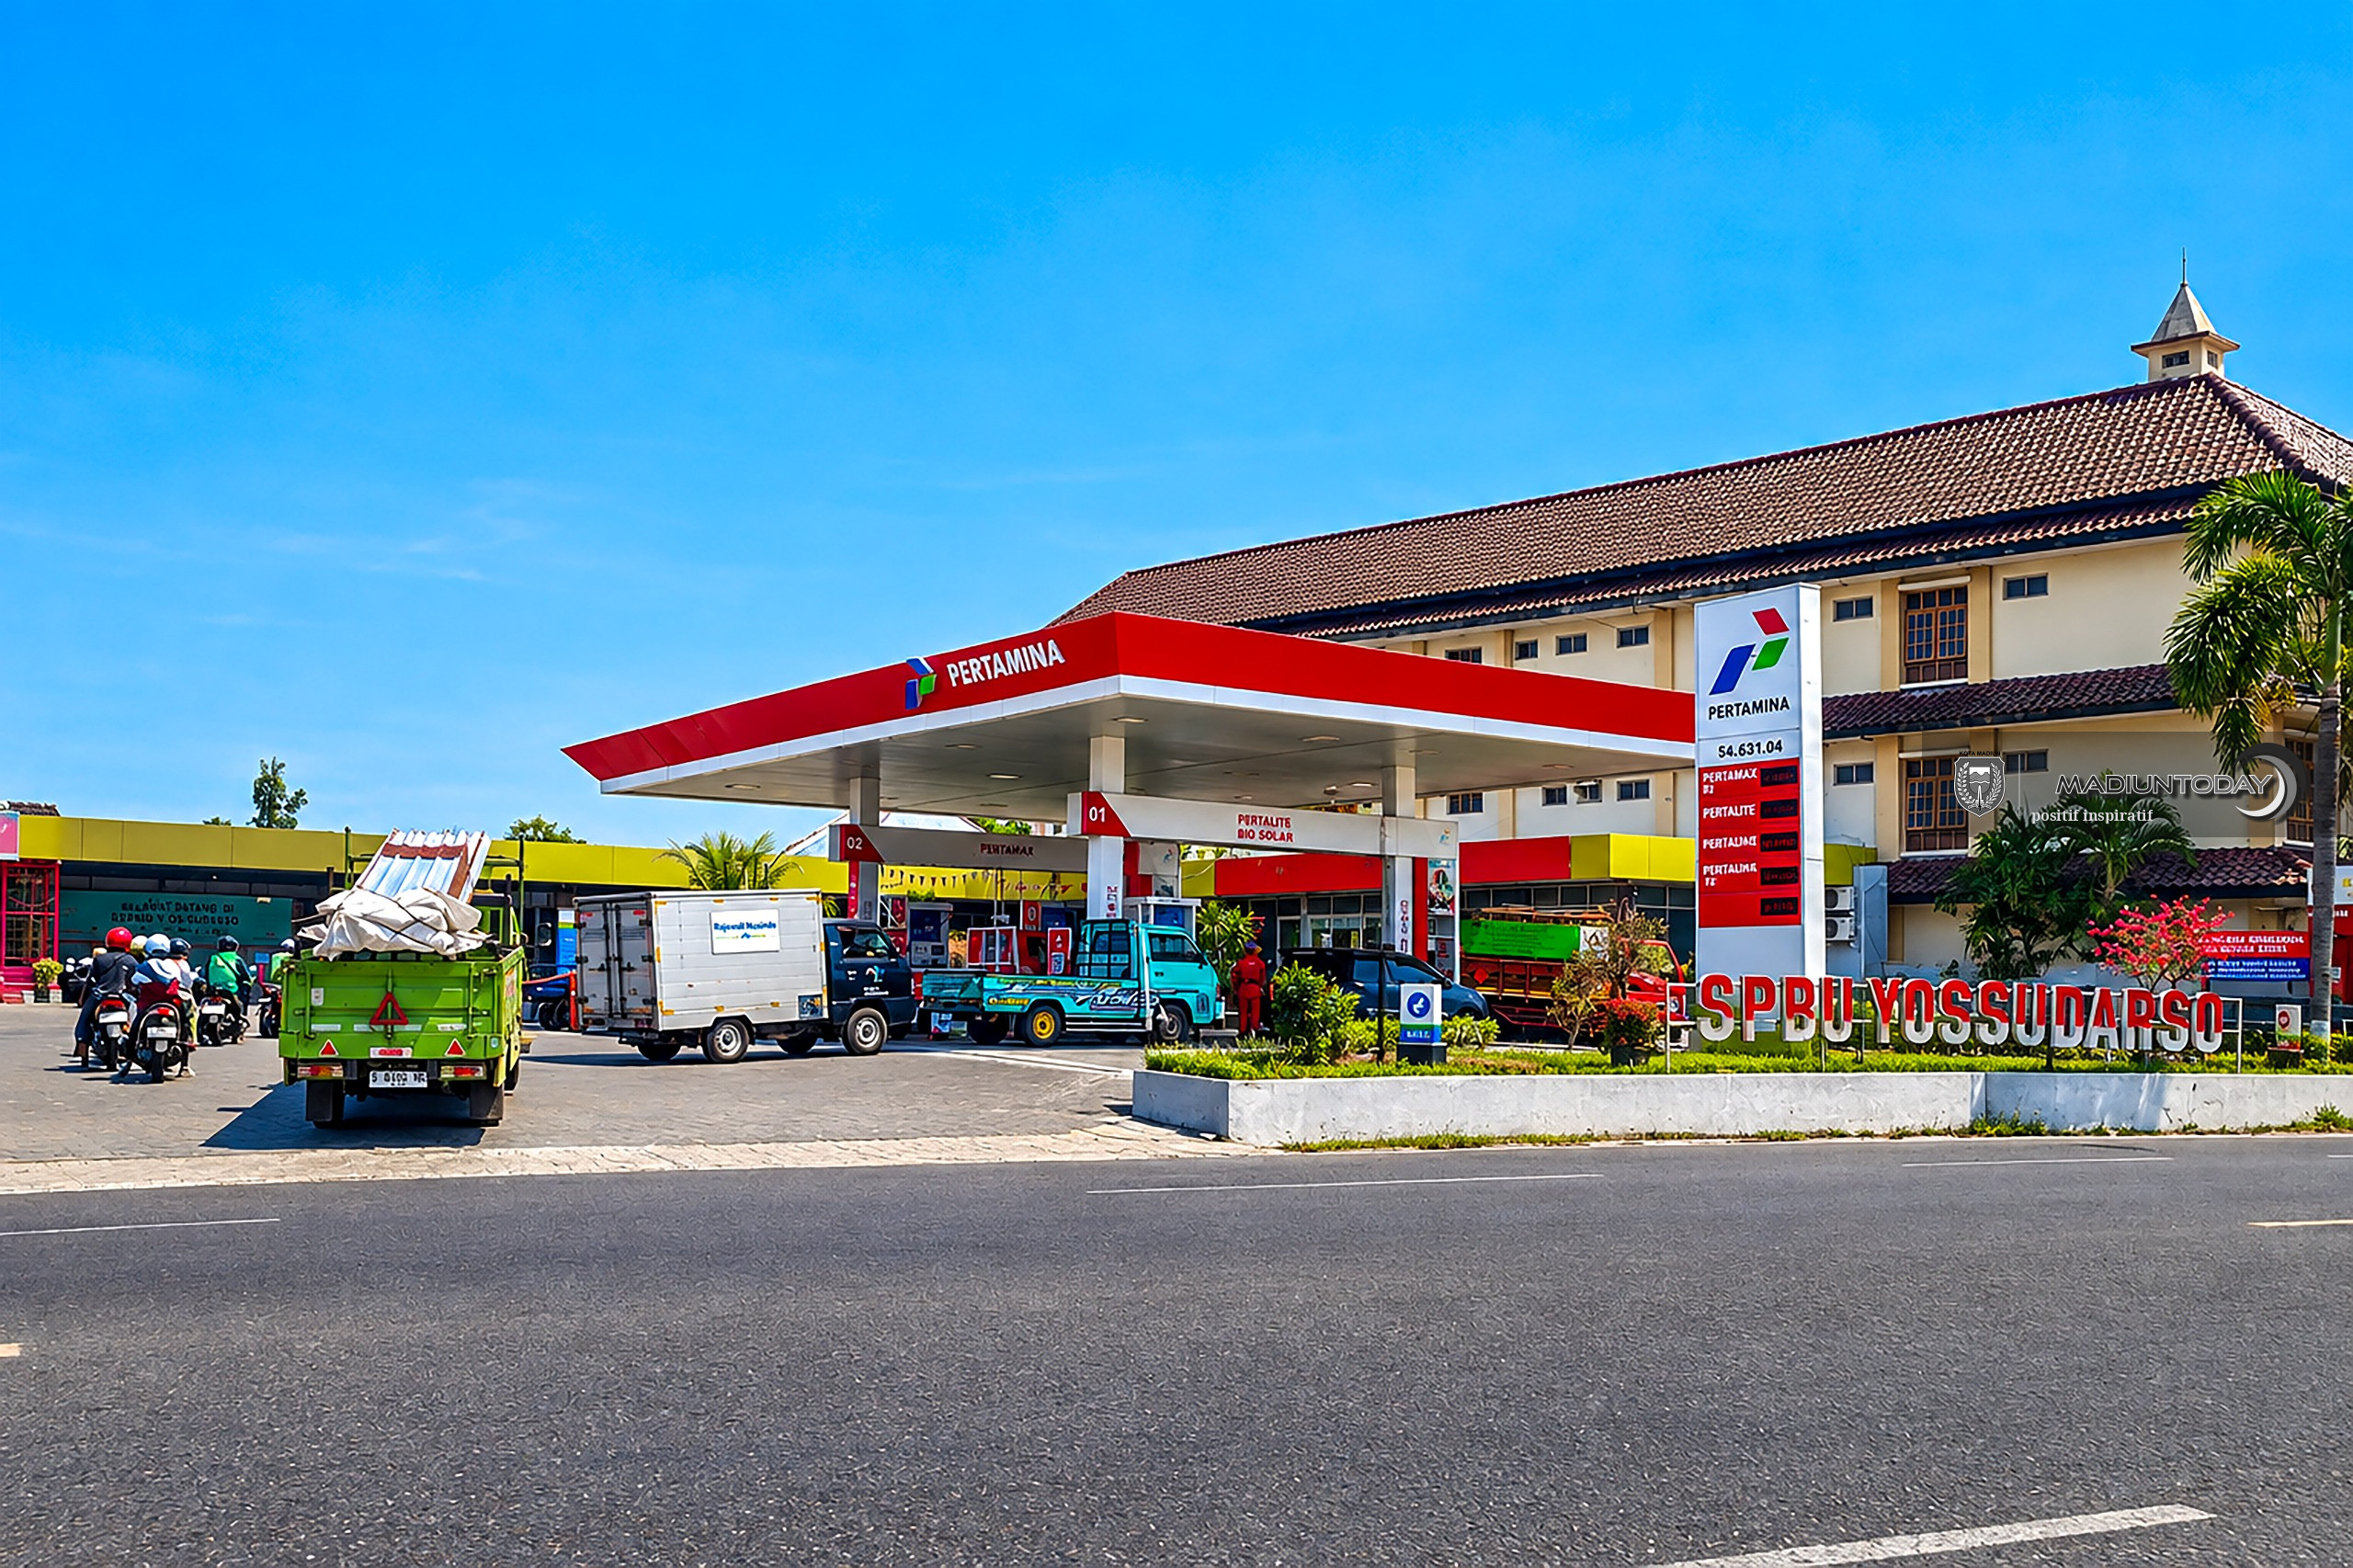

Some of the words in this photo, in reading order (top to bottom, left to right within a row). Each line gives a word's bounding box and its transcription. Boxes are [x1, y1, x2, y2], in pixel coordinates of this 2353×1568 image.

[946, 639, 1066, 687] PERTAMINA
[1708, 696, 1790, 721] PERTAMINA
[1717, 739, 1783, 759] 54.631.04
[1702, 767, 1757, 783] PERTAMAX
[1088, 806, 1106, 823] 01
[1702, 803, 1756, 819] PERTALITE
[846, 836, 863, 850] 02
[1258, 829, 1294, 843] SOLAR
[1699, 972, 1853, 1044] SPBU
